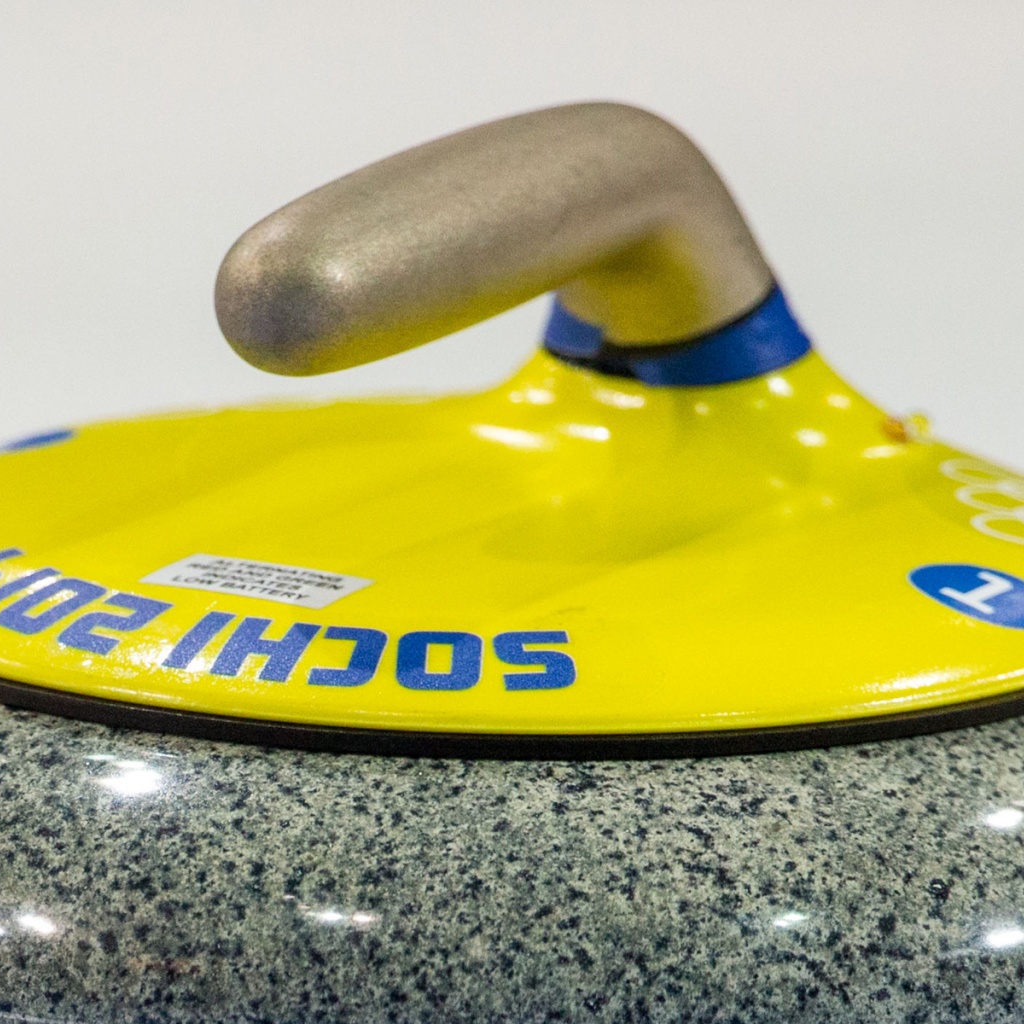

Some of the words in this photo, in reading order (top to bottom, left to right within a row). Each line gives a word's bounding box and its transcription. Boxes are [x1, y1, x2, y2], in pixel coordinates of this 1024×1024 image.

[187, 562, 227, 572] RED
[233, 568, 272, 578] AND
[276, 573, 344, 590] GREEN
[202, 571, 302, 591] INDICATES
[214, 559, 344, 582] ALTERNATING
[172, 575, 219, 586] LOW
[220, 581, 311, 601] BATTERY
[939, 570, 1014, 615] 1
[162, 611, 578, 691] SOCHI
